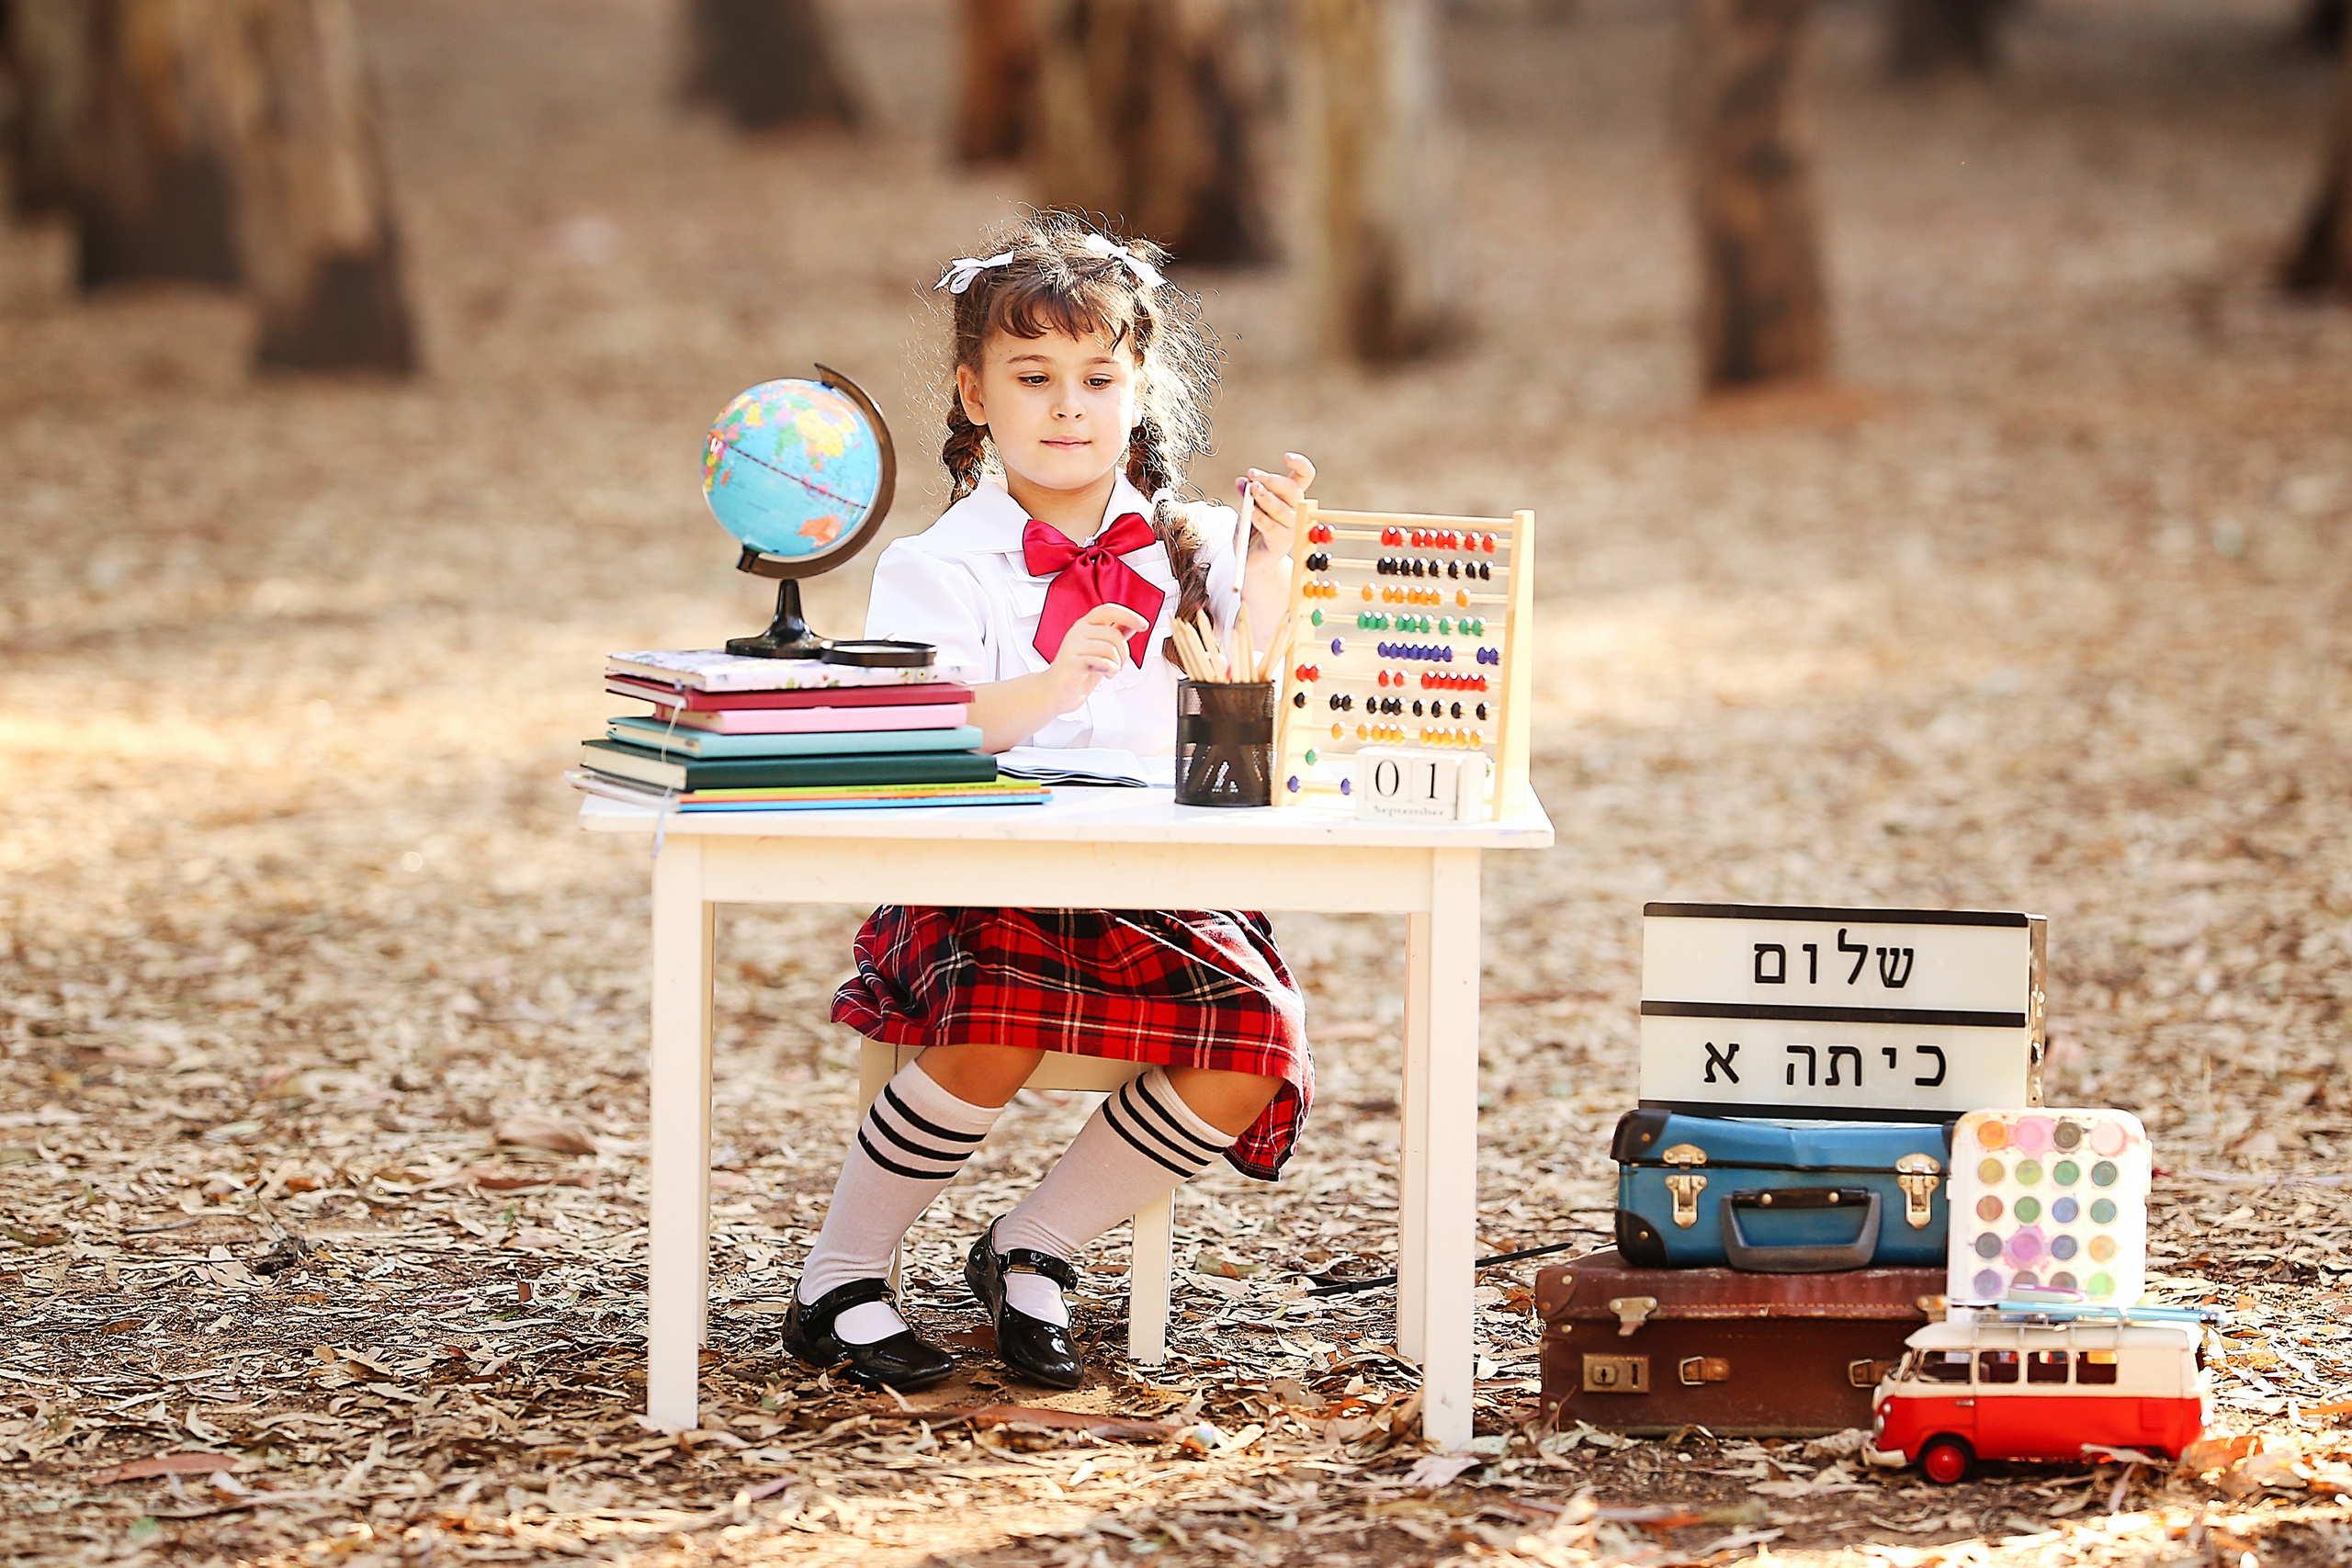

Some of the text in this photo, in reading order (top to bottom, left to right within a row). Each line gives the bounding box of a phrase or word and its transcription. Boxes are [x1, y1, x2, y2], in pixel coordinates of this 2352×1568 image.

[1753, 928, 1914, 988] שלום
[1703, 1042, 1947, 1088] כיתה א
